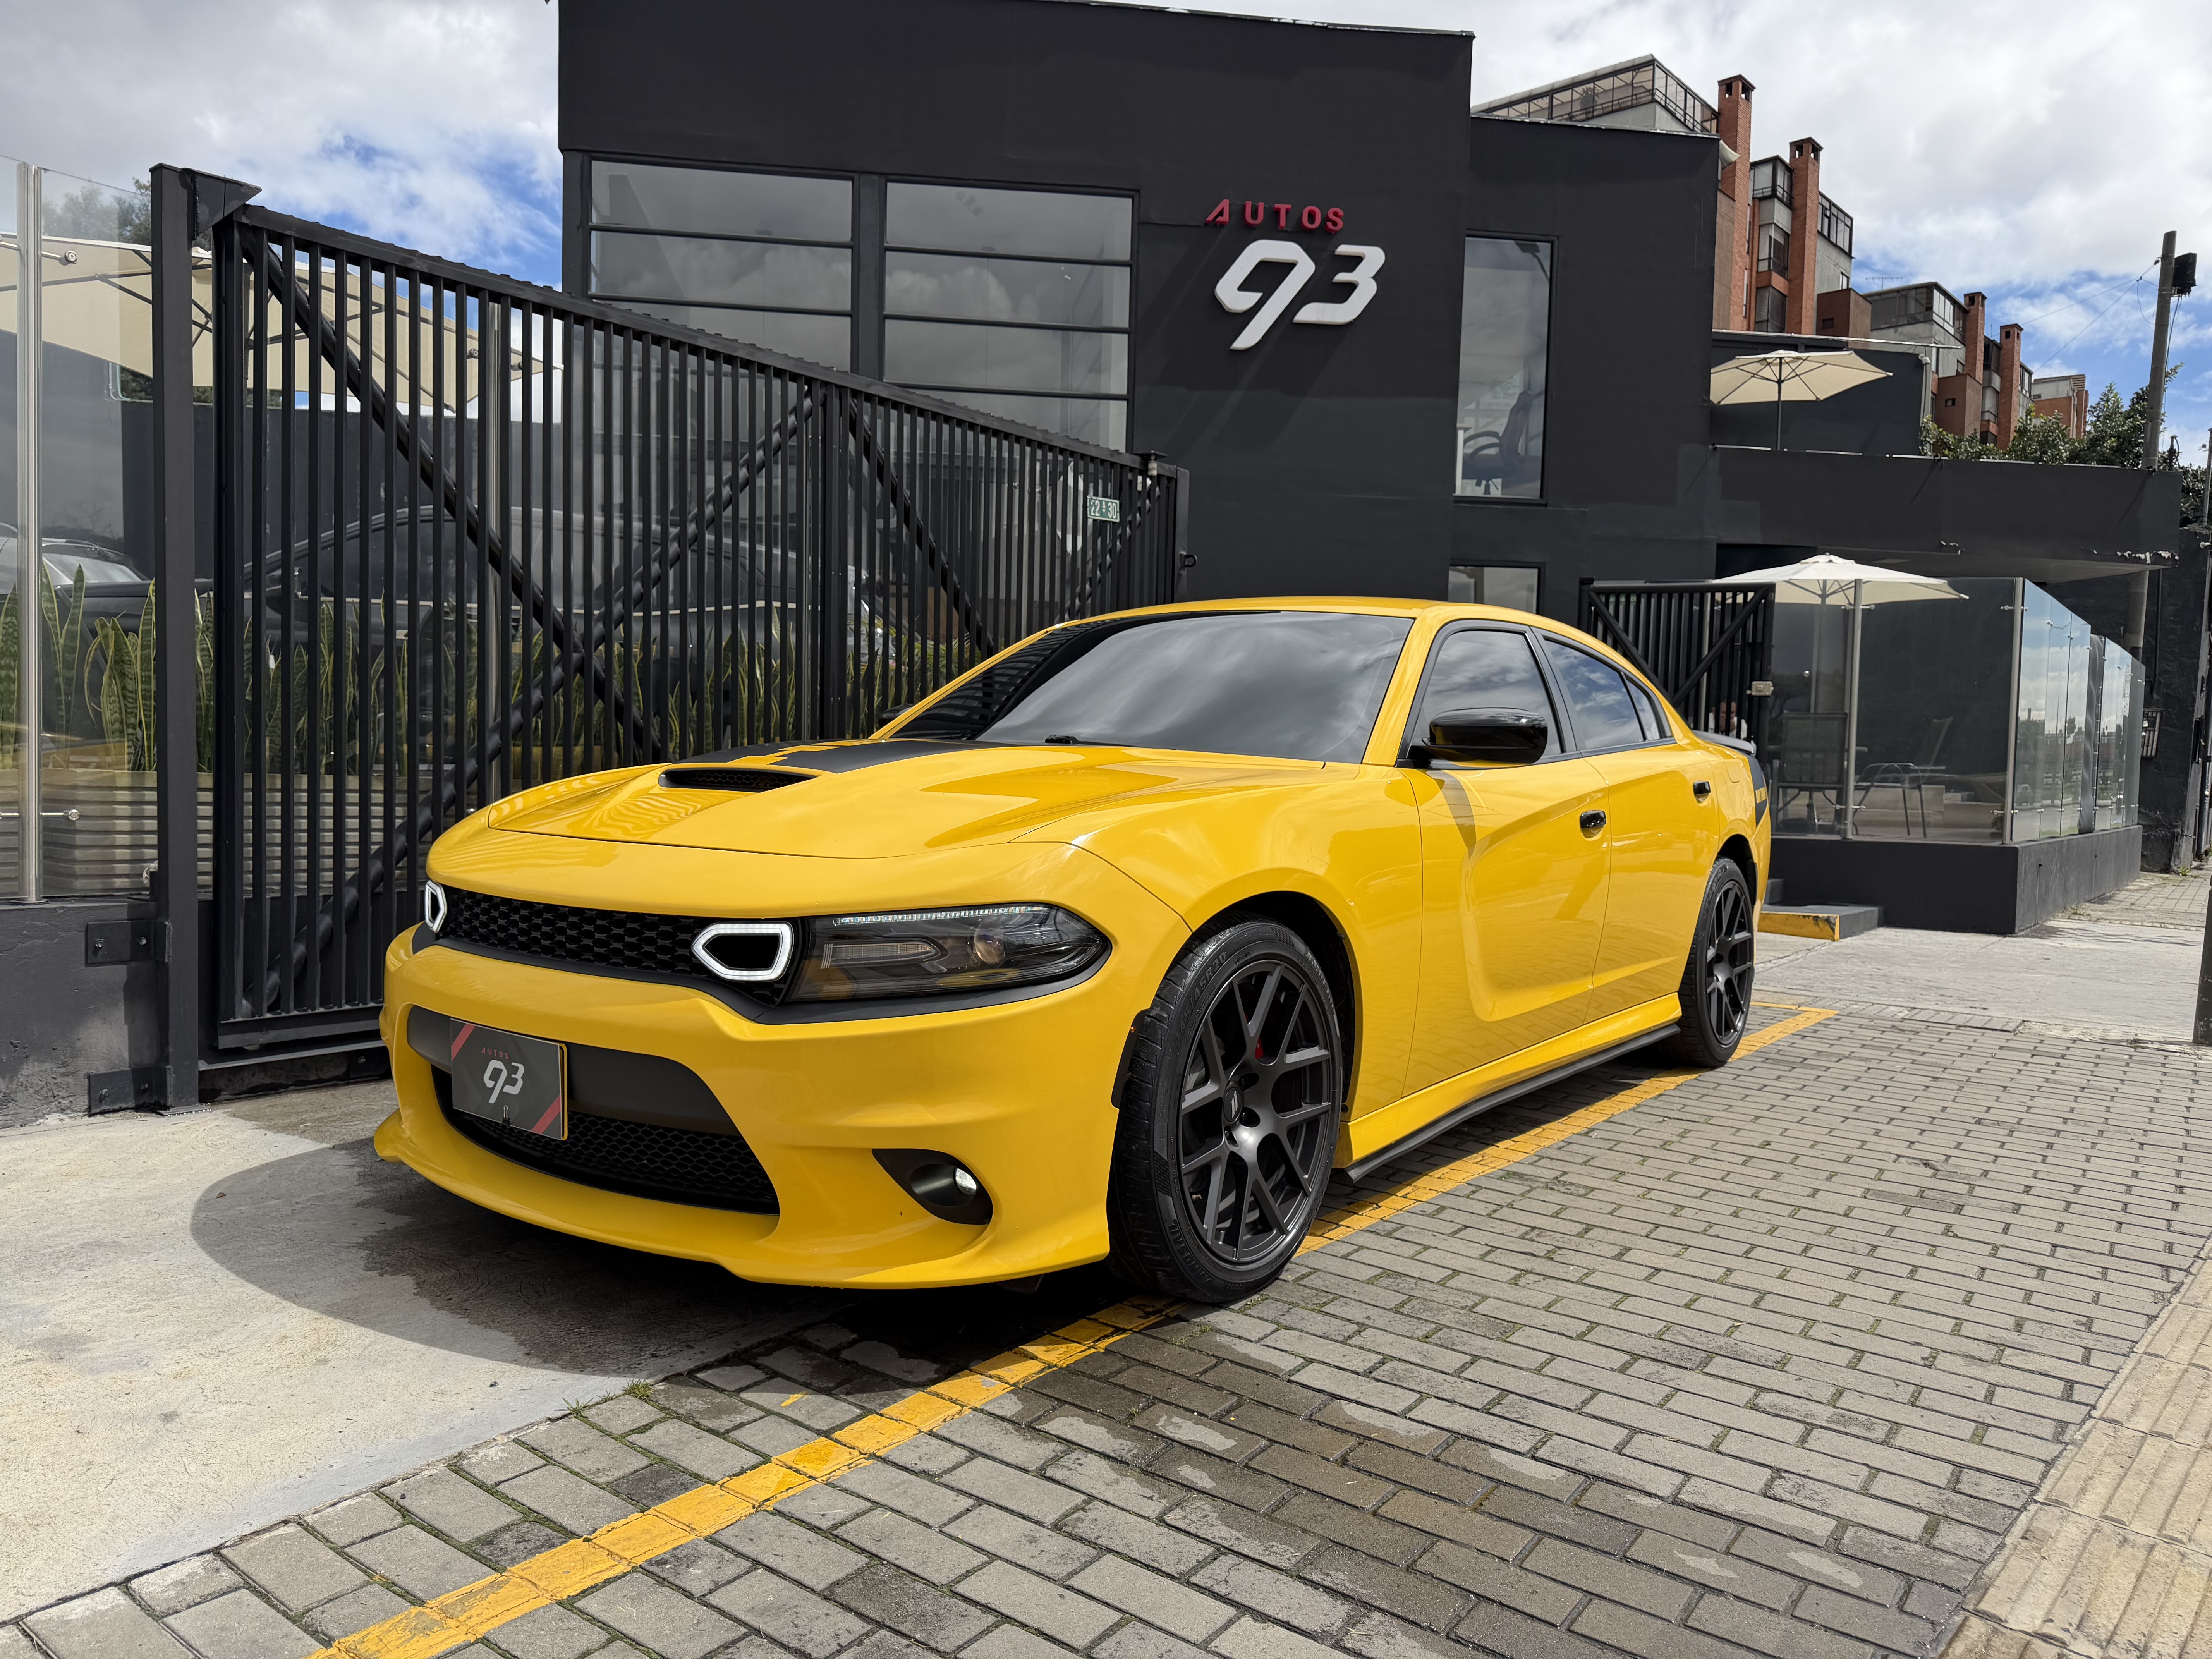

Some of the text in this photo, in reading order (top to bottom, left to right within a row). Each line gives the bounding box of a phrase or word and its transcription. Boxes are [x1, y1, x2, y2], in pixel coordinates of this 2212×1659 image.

[1205, 199, 1344, 233] AUTOS
[1214, 239, 1386, 350] 93
[1108, 502, 1117, 519] 30
[481, 1047, 509, 1060] AUTOS
[483, 1059, 525, 1104] 93
